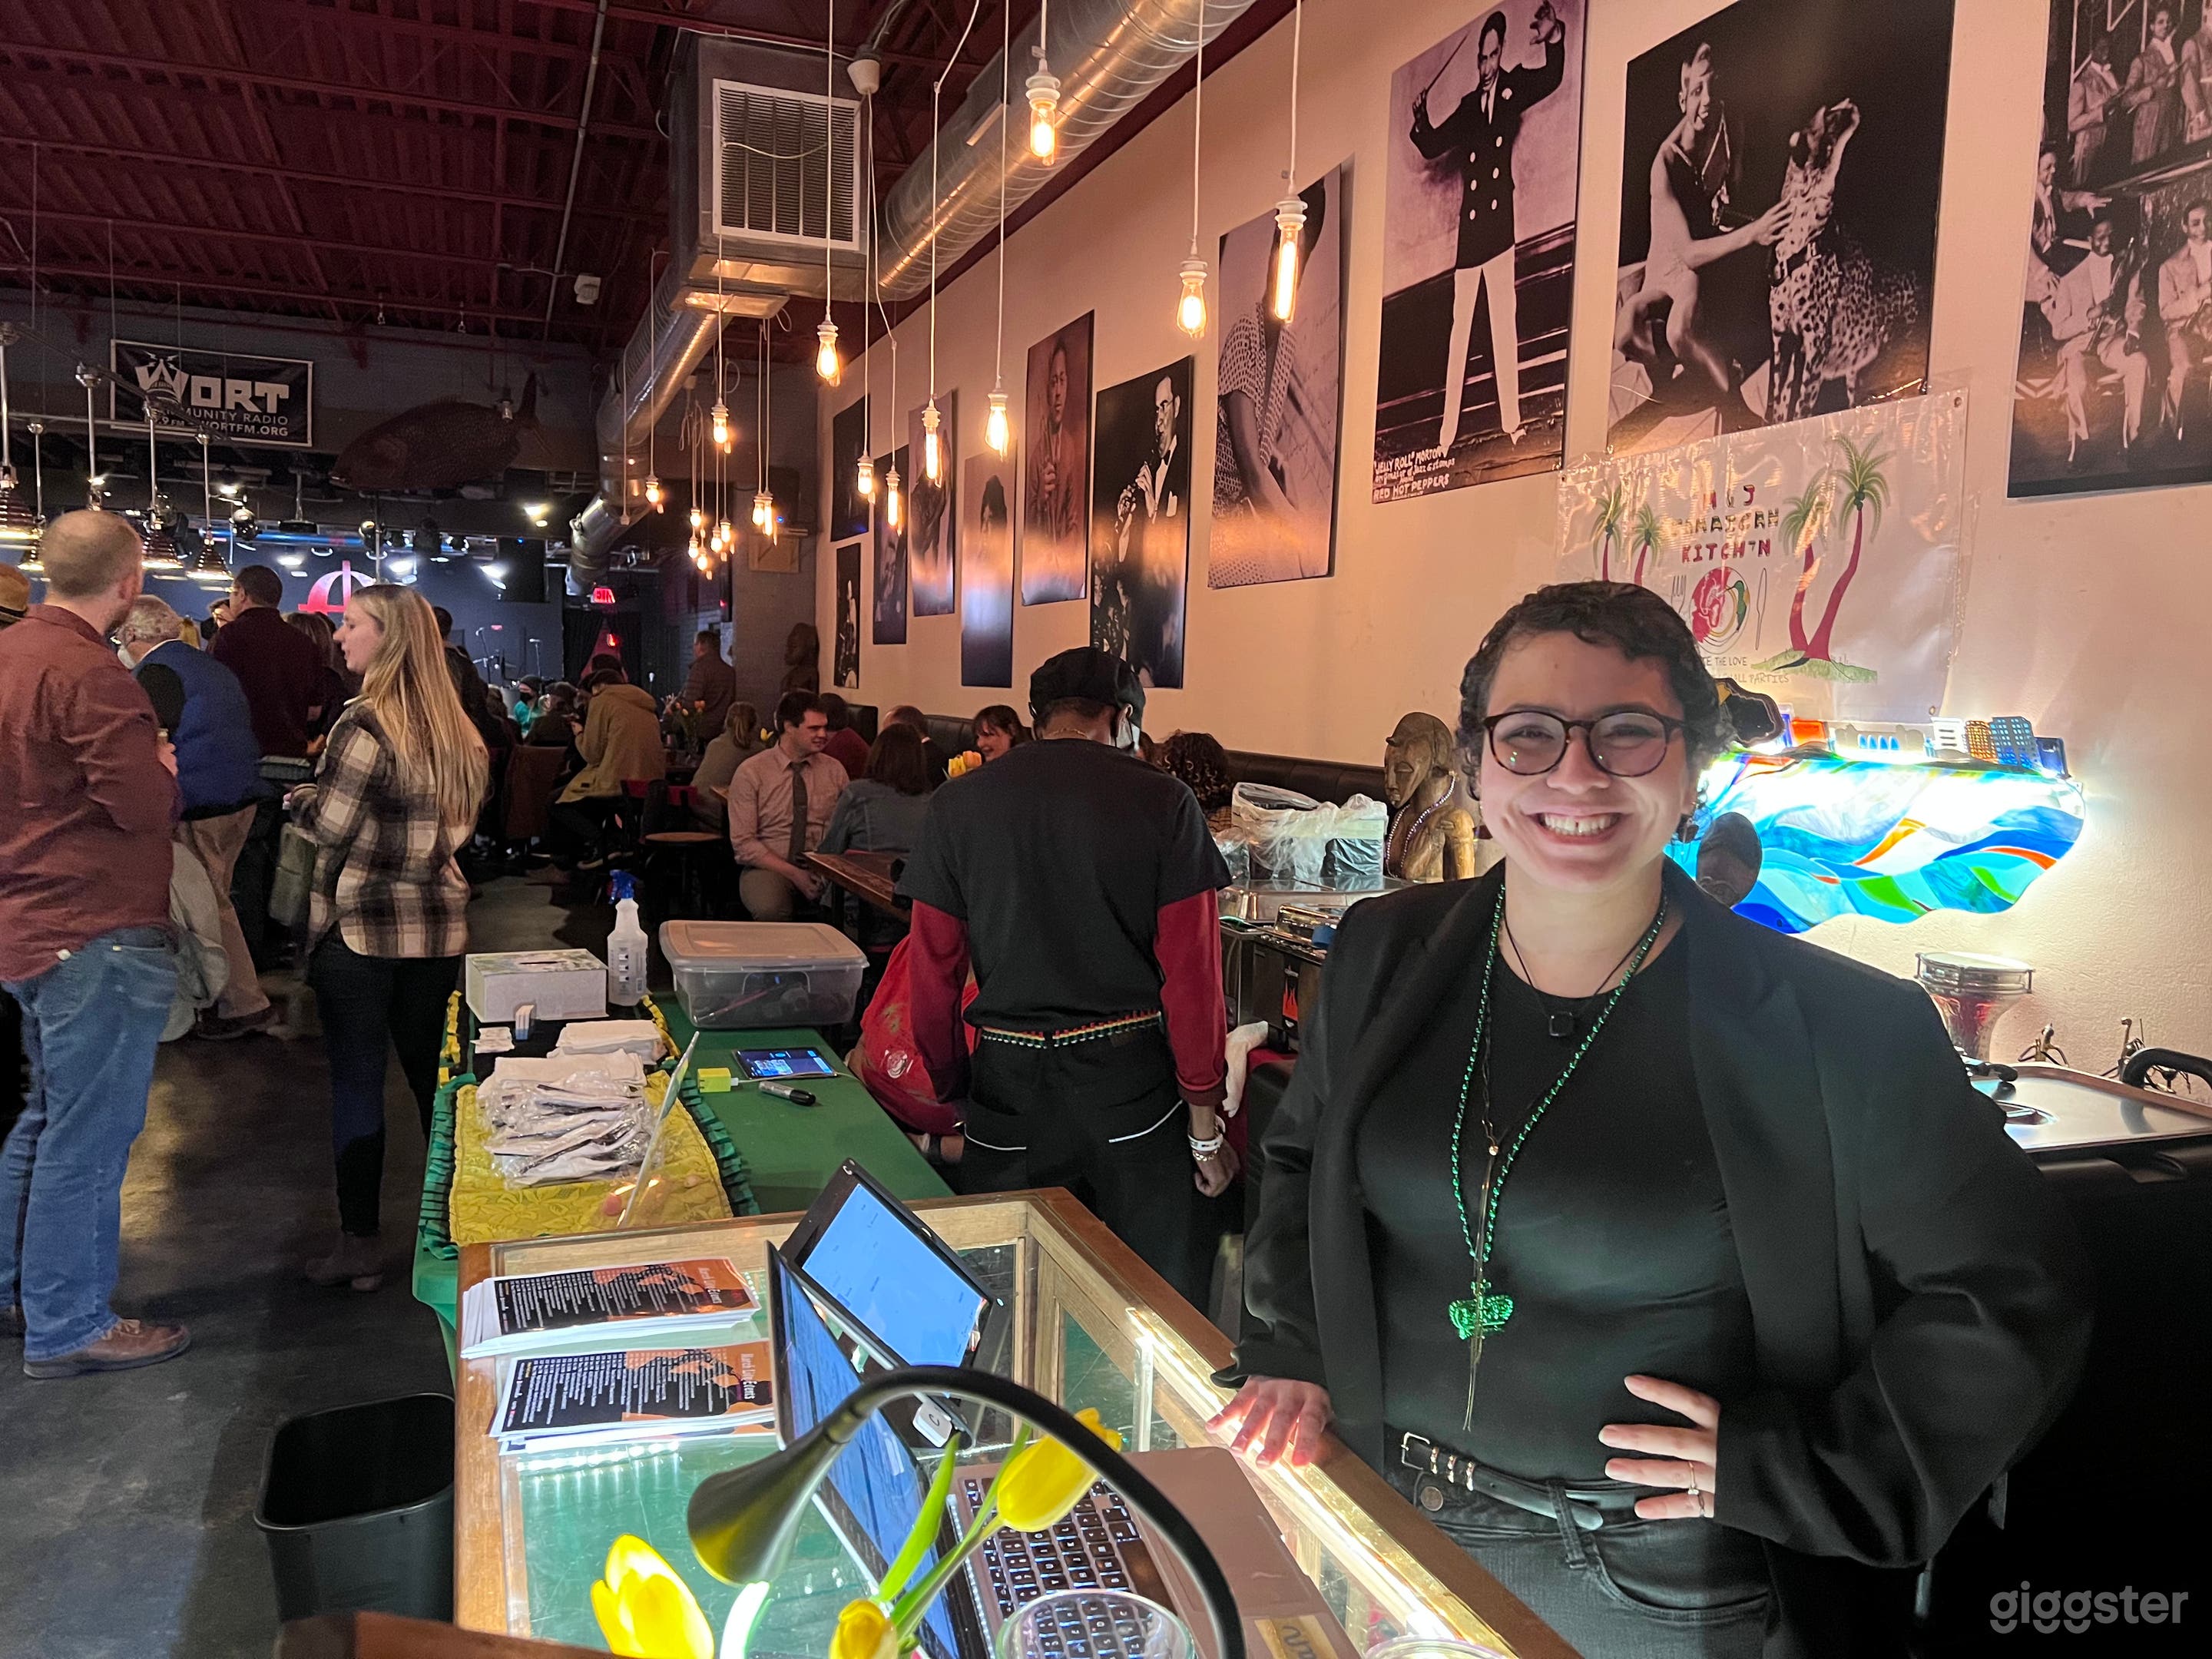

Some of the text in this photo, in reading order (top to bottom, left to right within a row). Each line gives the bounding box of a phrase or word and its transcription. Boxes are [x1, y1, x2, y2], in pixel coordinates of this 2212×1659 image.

[135, 358, 290, 413] WORT
[243, 412, 288, 425] RADIO
[1373, 488, 1390, 501] RED
[1393, 483, 1410, 498] HOT
[1411, 473, 1450, 492] PEPPERS
[1728, 657, 1747, 666] LOVE
